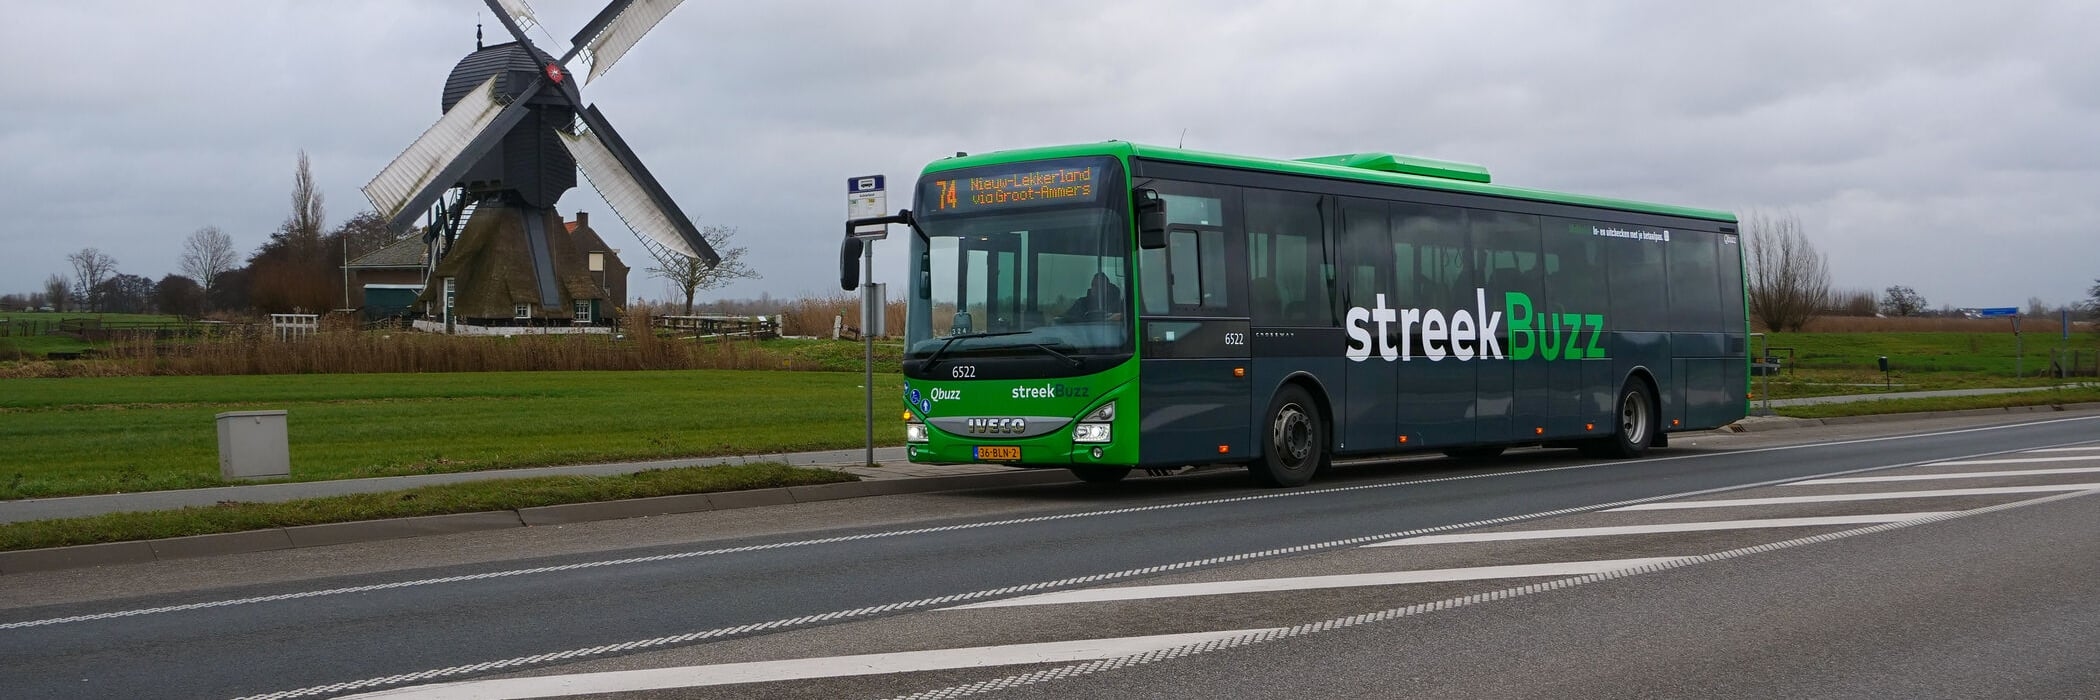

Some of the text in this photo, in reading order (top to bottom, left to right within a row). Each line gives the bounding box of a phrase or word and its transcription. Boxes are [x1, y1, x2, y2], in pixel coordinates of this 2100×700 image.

[970, 167, 1091, 191] Nieuw-Lekkerland
[936, 179, 957, 210] 74
[972, 184, 1091, 205] via Groot-Ammers
[1345, 288, 1606, 362] streekBuzz
[1225, 332, 1244, 345] 6522
[952, 366, 976, 378] 6522
[930, 387, 961, 401] Qbuzz
[1012, 383, 1090, 399] streekBuzz
[968, 417, 1025, 434] IVECO
[979, 447, 1017, 458] 36-BLN-2
